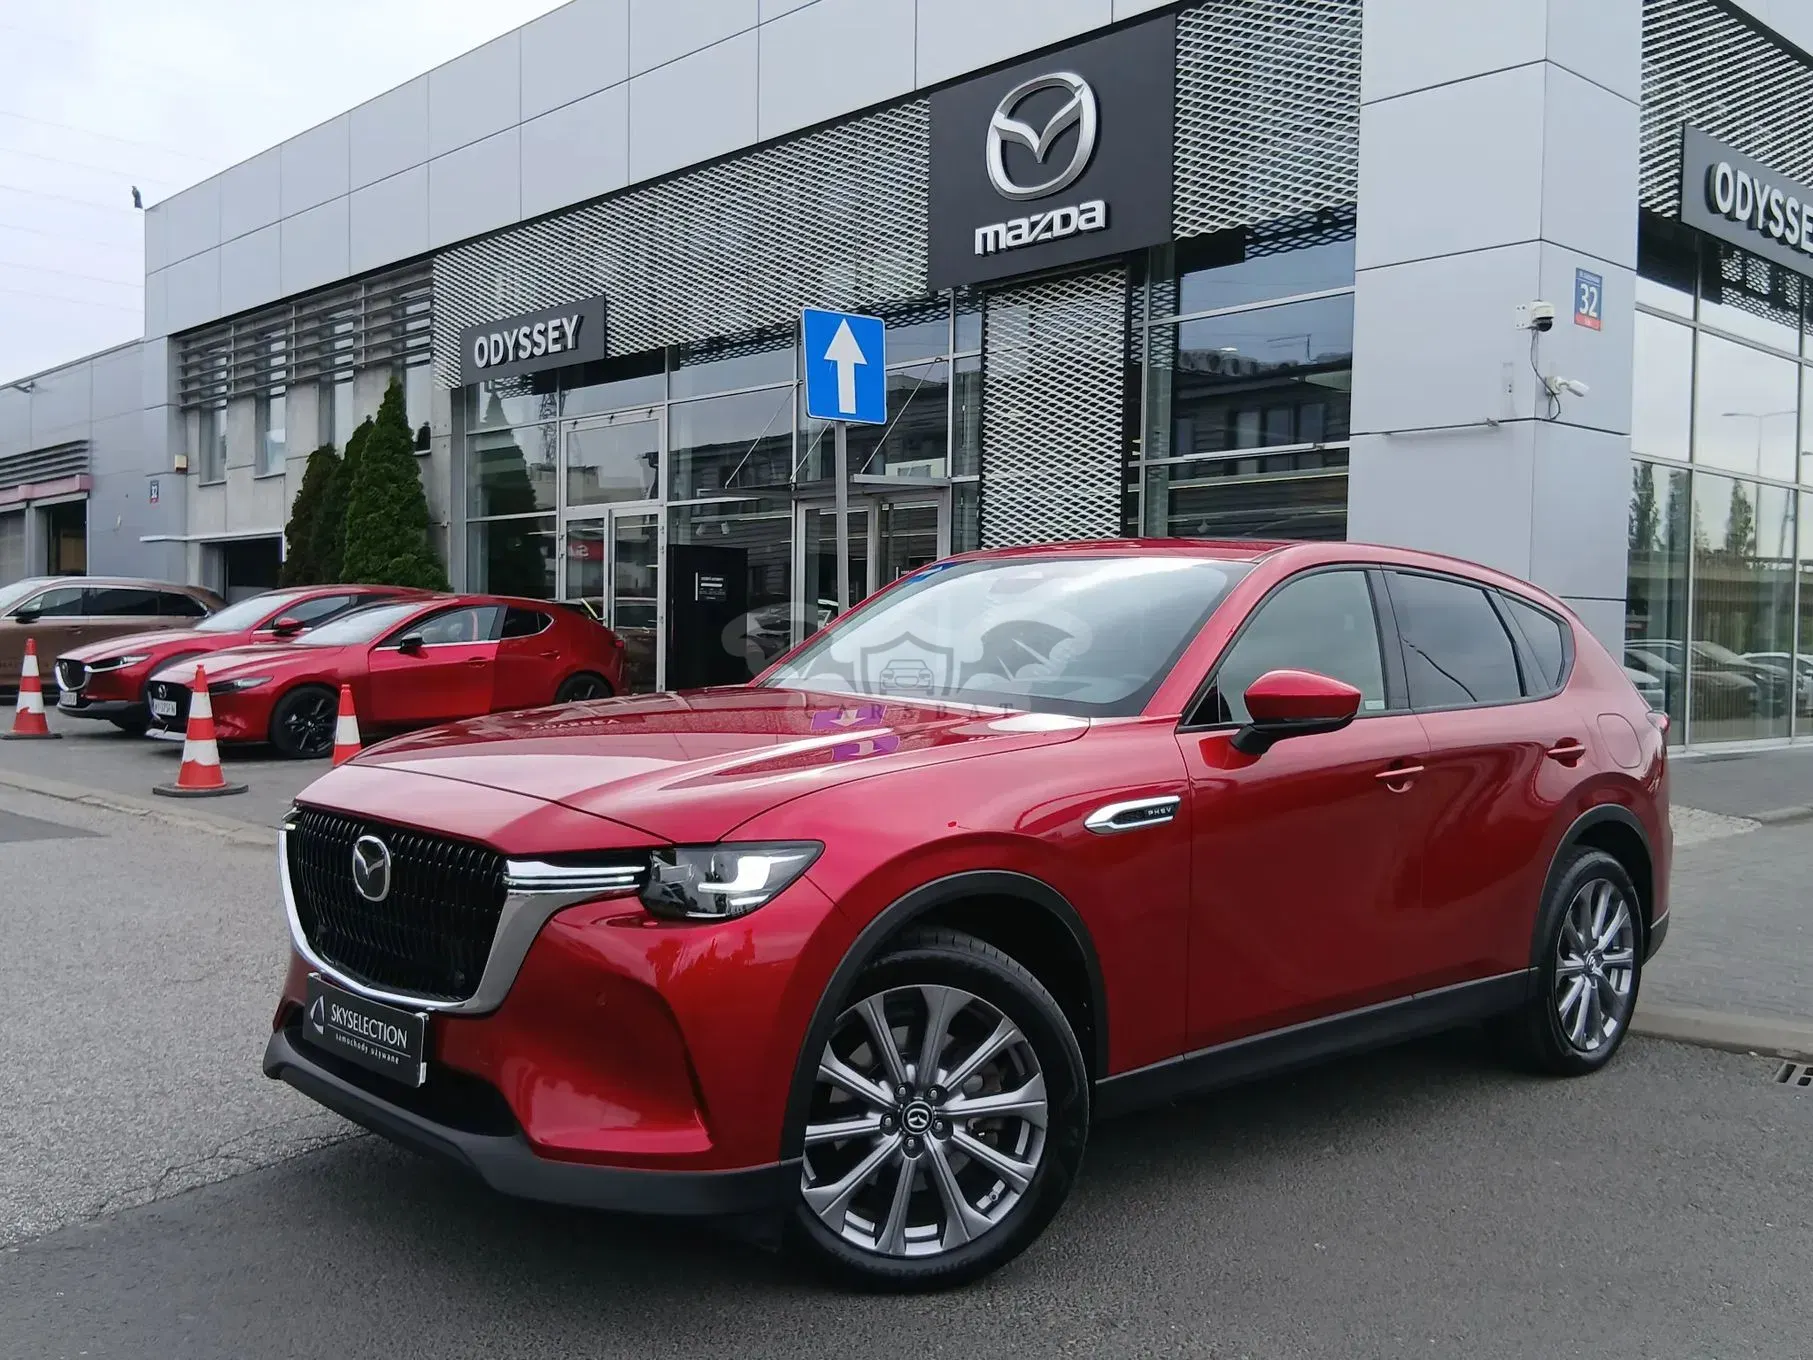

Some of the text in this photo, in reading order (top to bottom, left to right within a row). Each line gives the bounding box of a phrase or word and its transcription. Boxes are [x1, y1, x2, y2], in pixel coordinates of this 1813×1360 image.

[1579, 282, 1598, 318] 32
[473, 314, 581, 369] ODYSSEY
[1147, 806, 1172, 816] PHEV
[330, 1003, 408, 1049] SKYSELECTION
[335, 1033, 369, 1054] samochody
